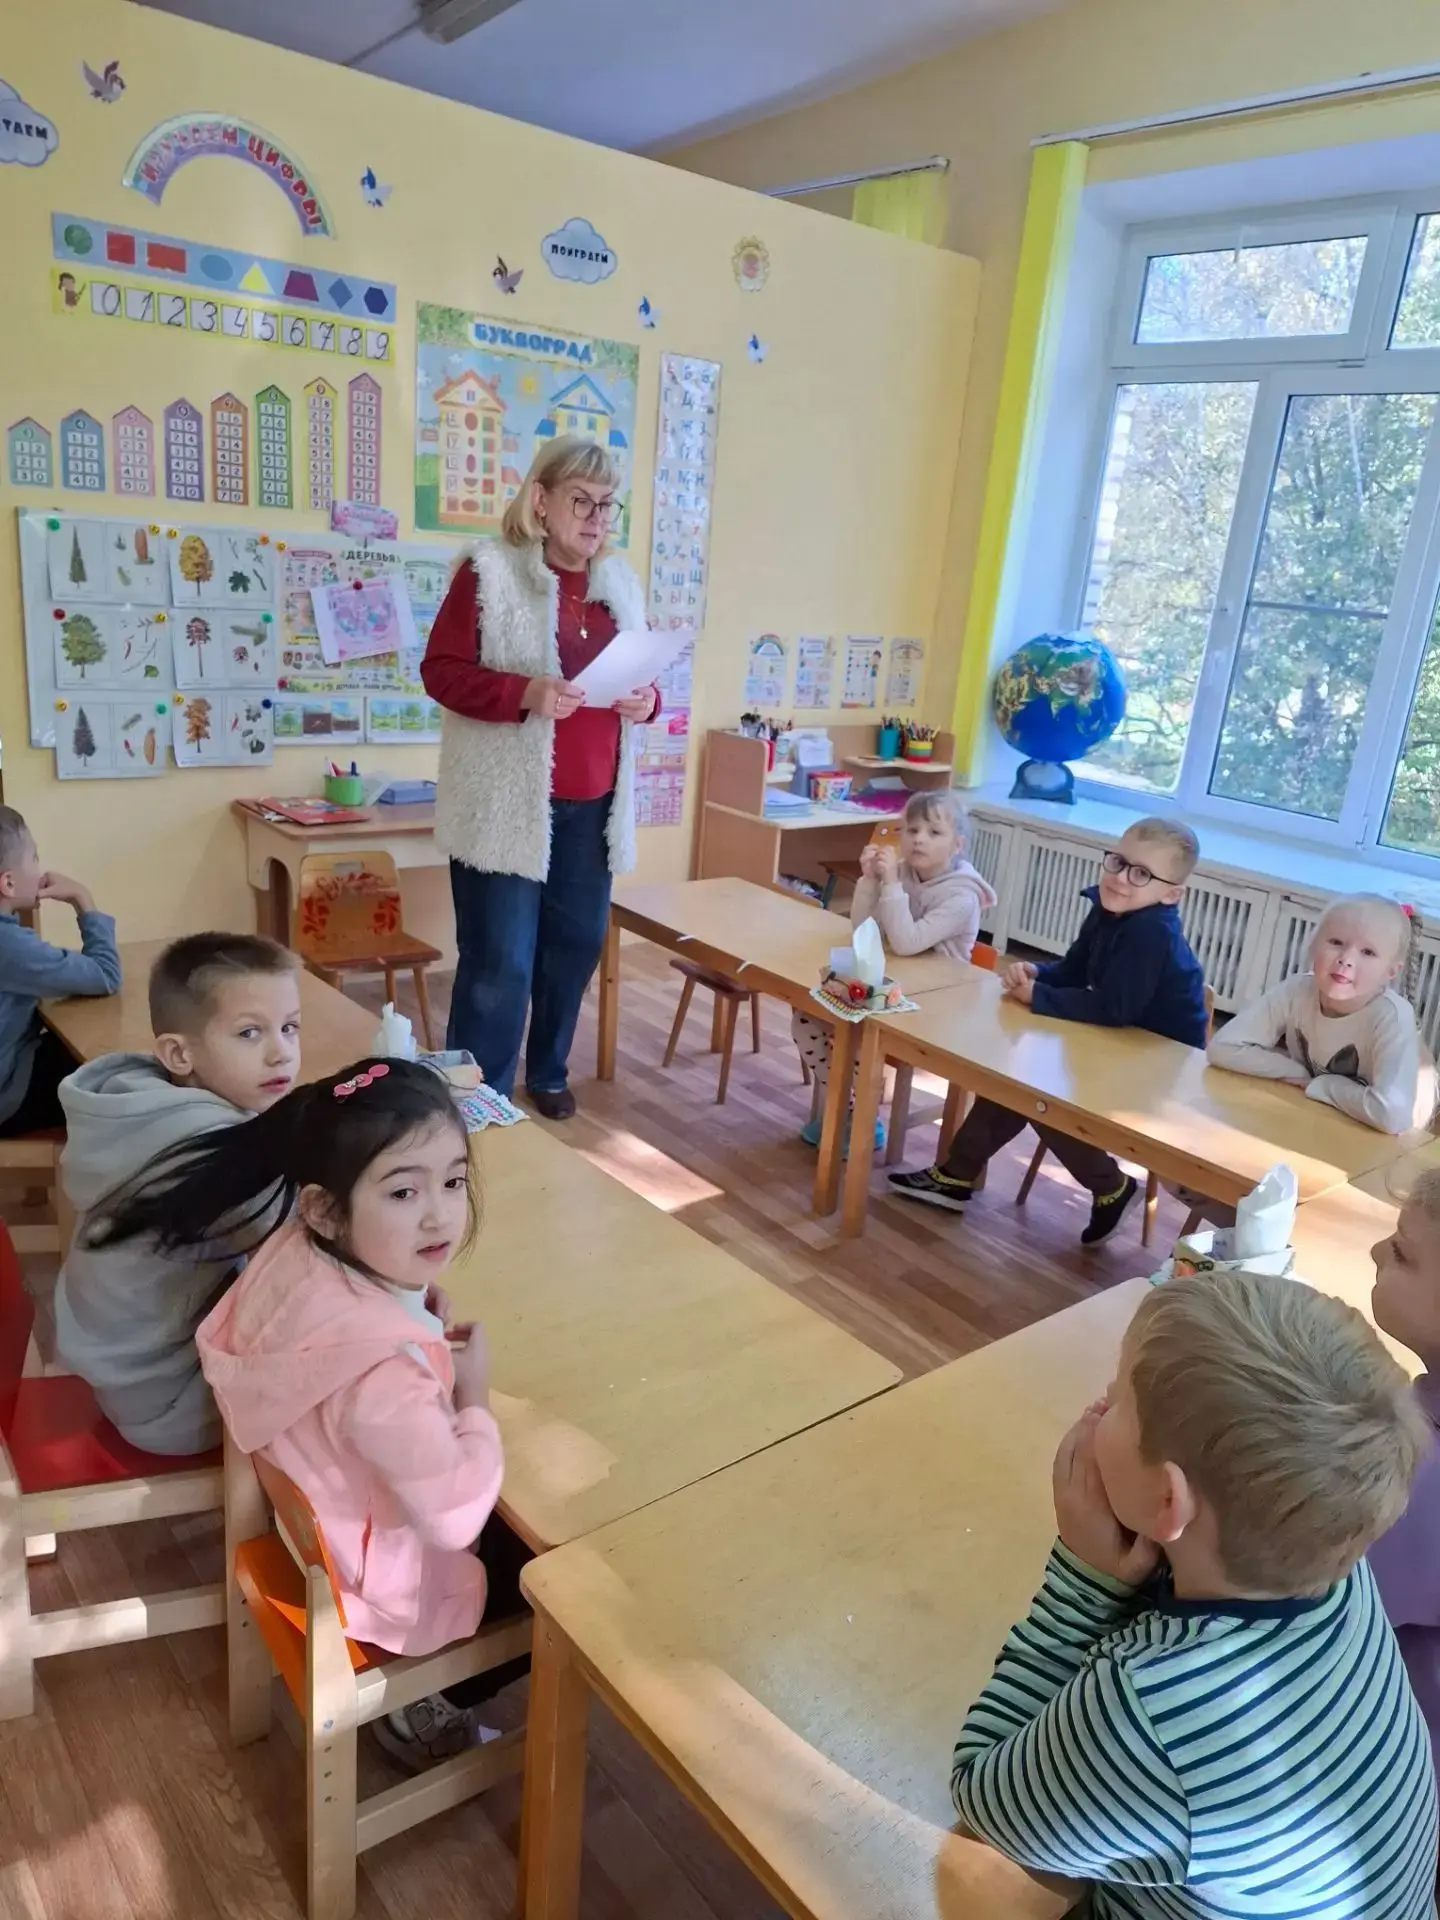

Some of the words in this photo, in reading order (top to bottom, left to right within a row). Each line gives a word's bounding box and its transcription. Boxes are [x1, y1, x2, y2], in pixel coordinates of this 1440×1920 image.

[247, 134, 322, 227] ЦИФРЫ
[551, 243, 608, 264] ПОИГРАЕМ
[102, 284, 120, 316] 0
[140, 291, 154, 321] 1
[168, 296, 186, 326] 2
[202, 301, 218, 332] 3
[234, 306, 248, 336] 4
[260, 312, 277, 342] 5
[290, 318, 306, 346] 6
[318, 322, 335, 350] 7
[347, 328, 362, 356] 8
[375, 332, 390, 360] 9
[474, 322, 593, 363] БУКВОГРАД
[346, 550, 396, 563] ДЕРЕВЬЯ
[672, 572, 684, 586] Ш
[670, 590, 682, 604] Ы
[688, 590, 696, 605] Ь
